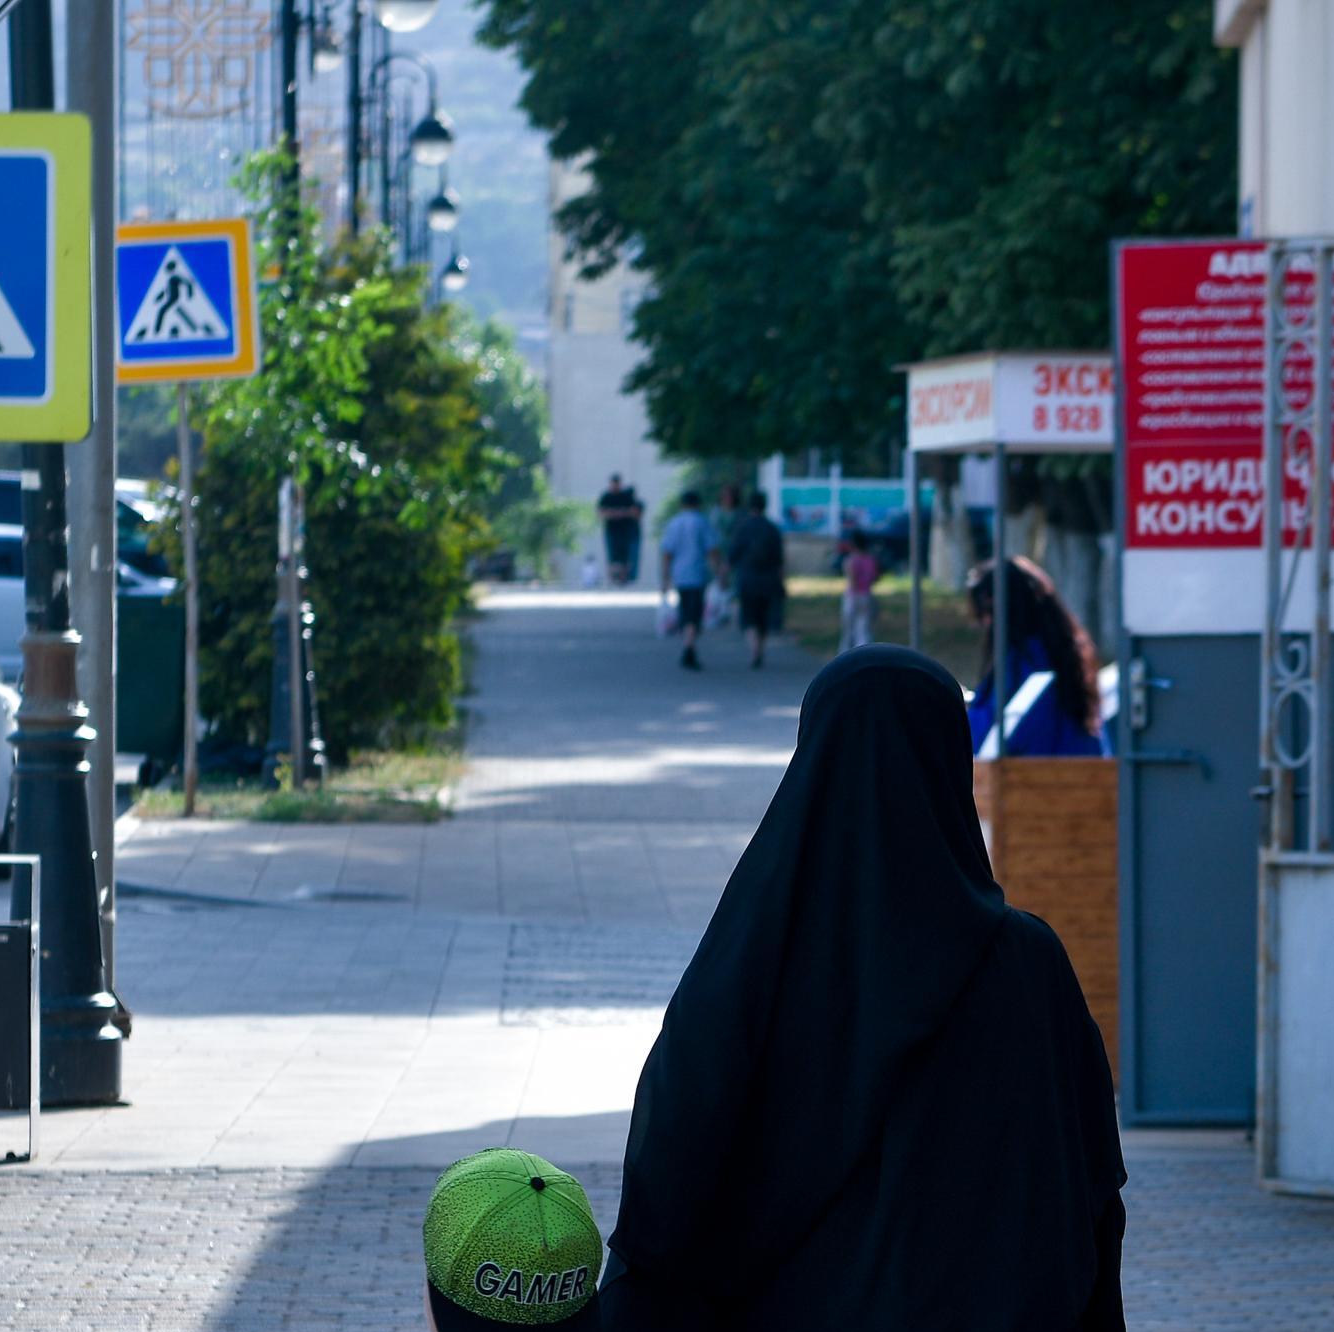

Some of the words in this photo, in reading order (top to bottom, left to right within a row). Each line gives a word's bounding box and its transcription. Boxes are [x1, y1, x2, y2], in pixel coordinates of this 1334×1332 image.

[1032, 404, 1048, 432] 8
[1056, 404, 1102, 432] 928
[474, 1261, 588, 1304] GAMER
